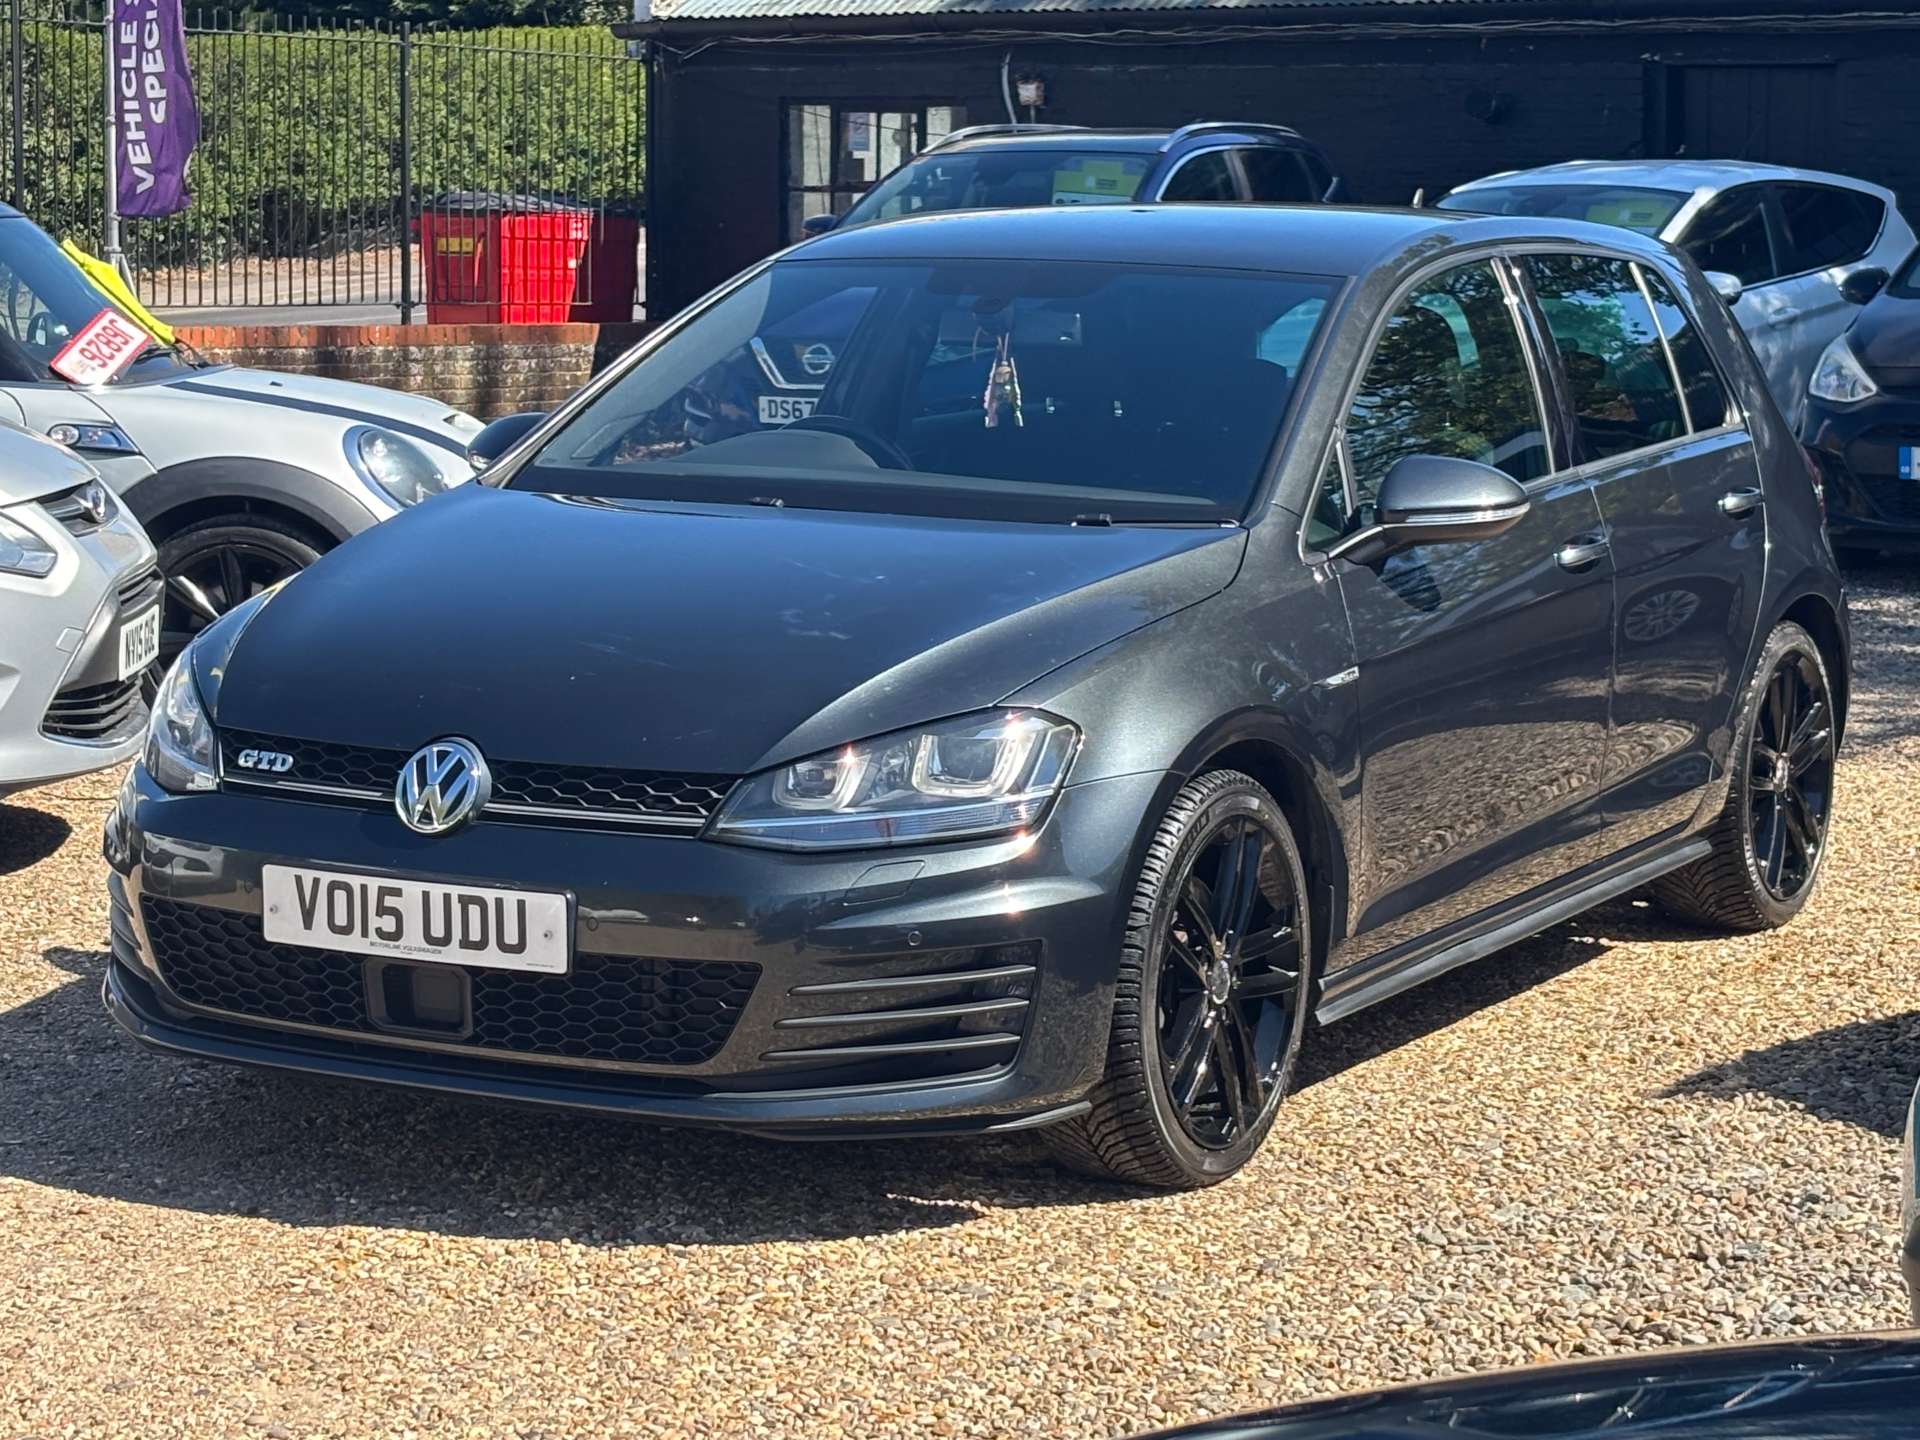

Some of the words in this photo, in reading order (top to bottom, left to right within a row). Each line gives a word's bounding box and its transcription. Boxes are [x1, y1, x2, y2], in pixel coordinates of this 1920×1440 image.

[142, 0, 167, 124] SPECI
[121, 20, 155, 194] VEHICLE
[767, 399, 816, 419] DS67
[237, 749, 294, 772] GTD
[294, 874, 404, 942] VO15
[422, 890, 528, 954] UDU
